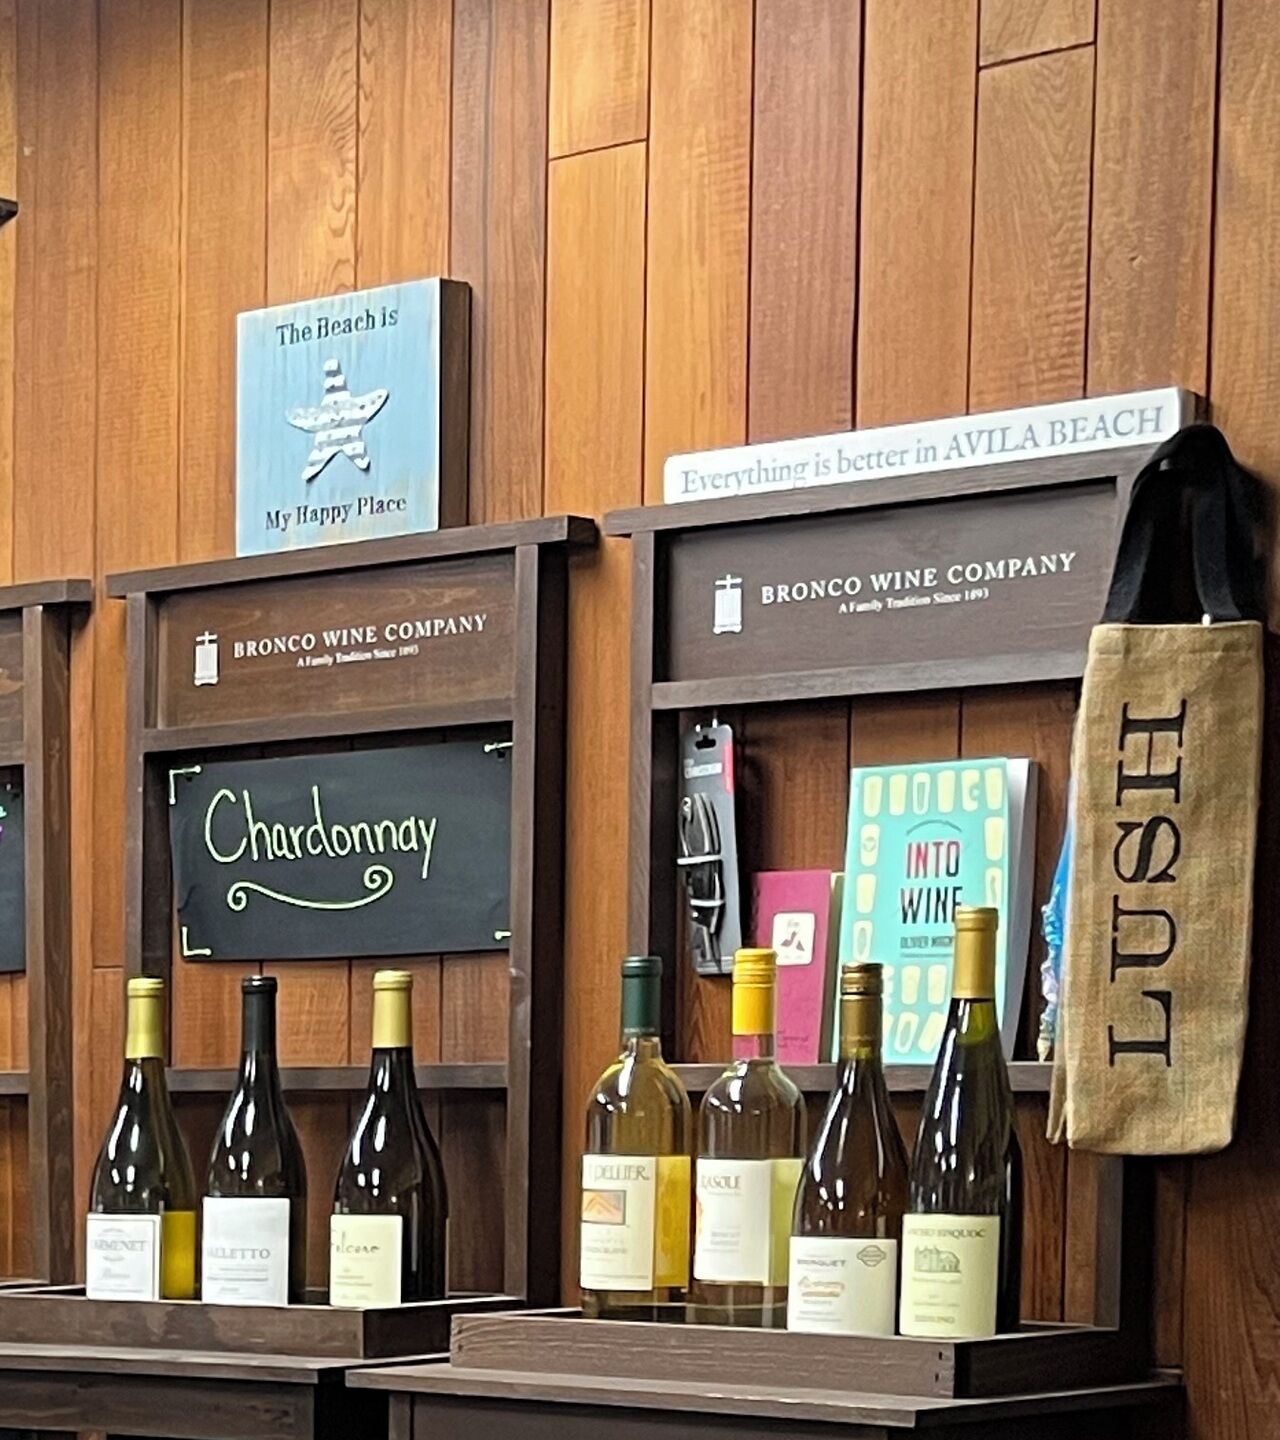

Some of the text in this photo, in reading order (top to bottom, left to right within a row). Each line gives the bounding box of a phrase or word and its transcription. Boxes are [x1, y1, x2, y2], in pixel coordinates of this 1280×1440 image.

[276, 306, 398, 347] The Beach is
[681, 406, 1164, 493] Everything is better in AVILA BEACH
[265, 496, 407, 532] My Happy Place
[761, 552, 1076, 605] BRONCO WINE COMPANY
[838, 587, 990, 614] A Family Tradition Since 1893
[233, 614, 487, 659] BRONCO WINE COMPANY
[205, 785, 438, 878] Chardonnay
[906, 840, 961, 879] INTO
[1107, 698, 1187, 1069] LUSH
